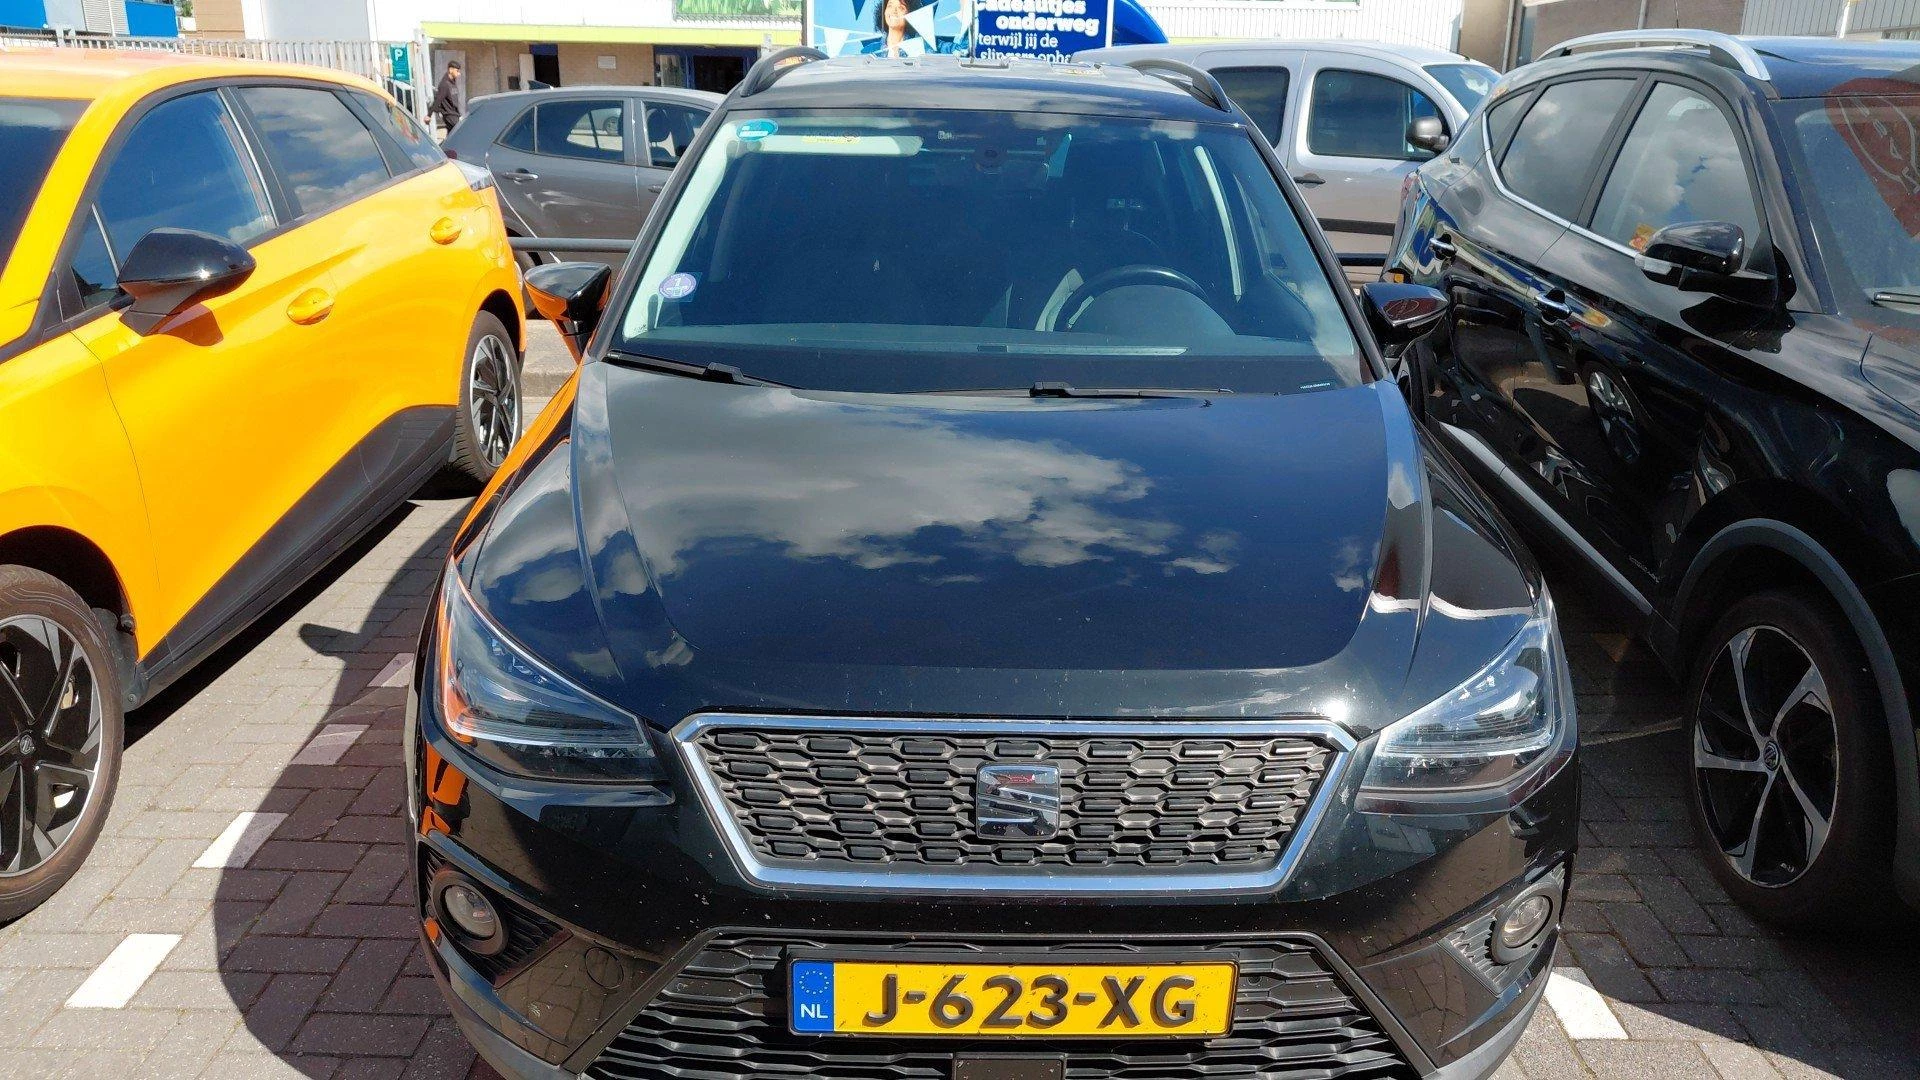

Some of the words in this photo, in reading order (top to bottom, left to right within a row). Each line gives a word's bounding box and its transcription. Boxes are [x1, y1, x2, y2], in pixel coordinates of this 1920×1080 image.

[996, 13, 1099, 37] onderweg
[979, 32, 1022, 49] terwijl
[1025, 32, 1037, 49] jij
[1040, 33, 1058, 48] de
[395, 48, 403, 61] P
[800, 1003, 828, 1018] NL
[861, 973, 1196, 1029] J-623-XG
